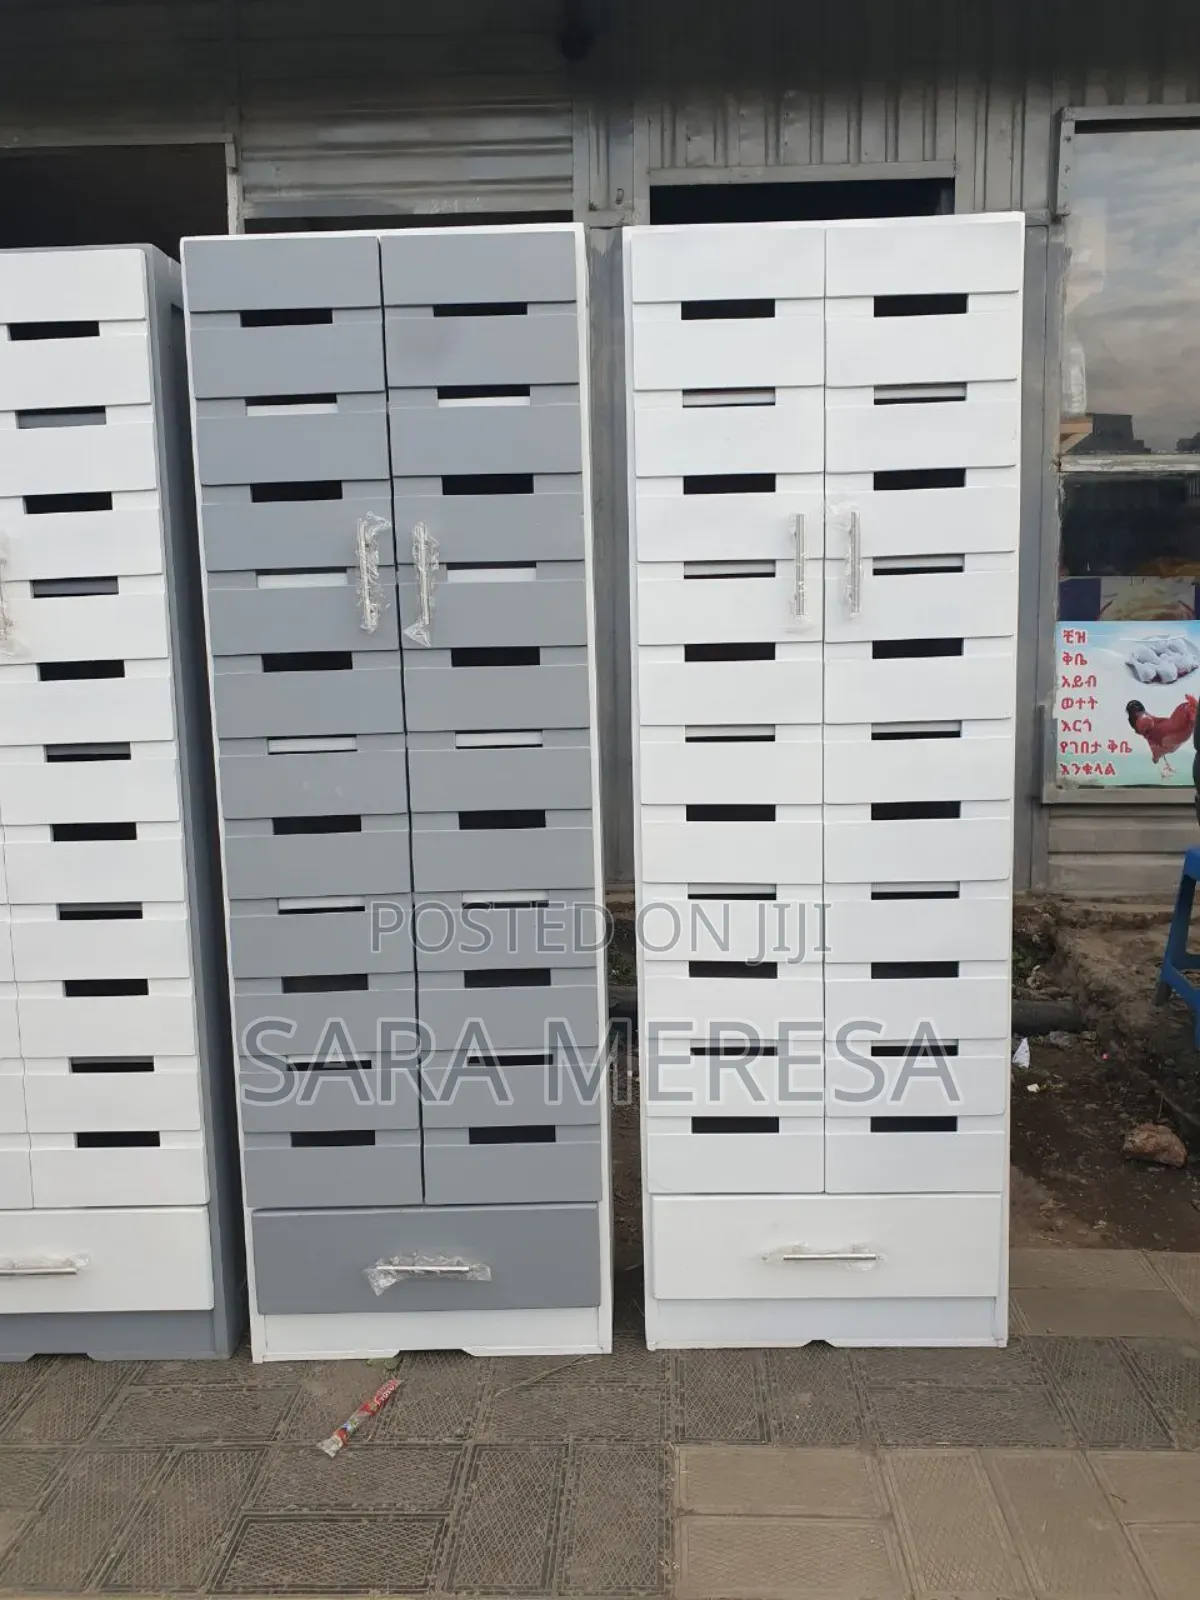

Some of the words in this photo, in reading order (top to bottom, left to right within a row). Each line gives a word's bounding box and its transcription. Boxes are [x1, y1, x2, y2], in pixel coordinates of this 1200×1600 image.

[1062, 652, 1087, 665] ቅቤ
[1061, 696, 1098, 710] ወተት
[1107, 739, 1132, 754] ቅቤ
